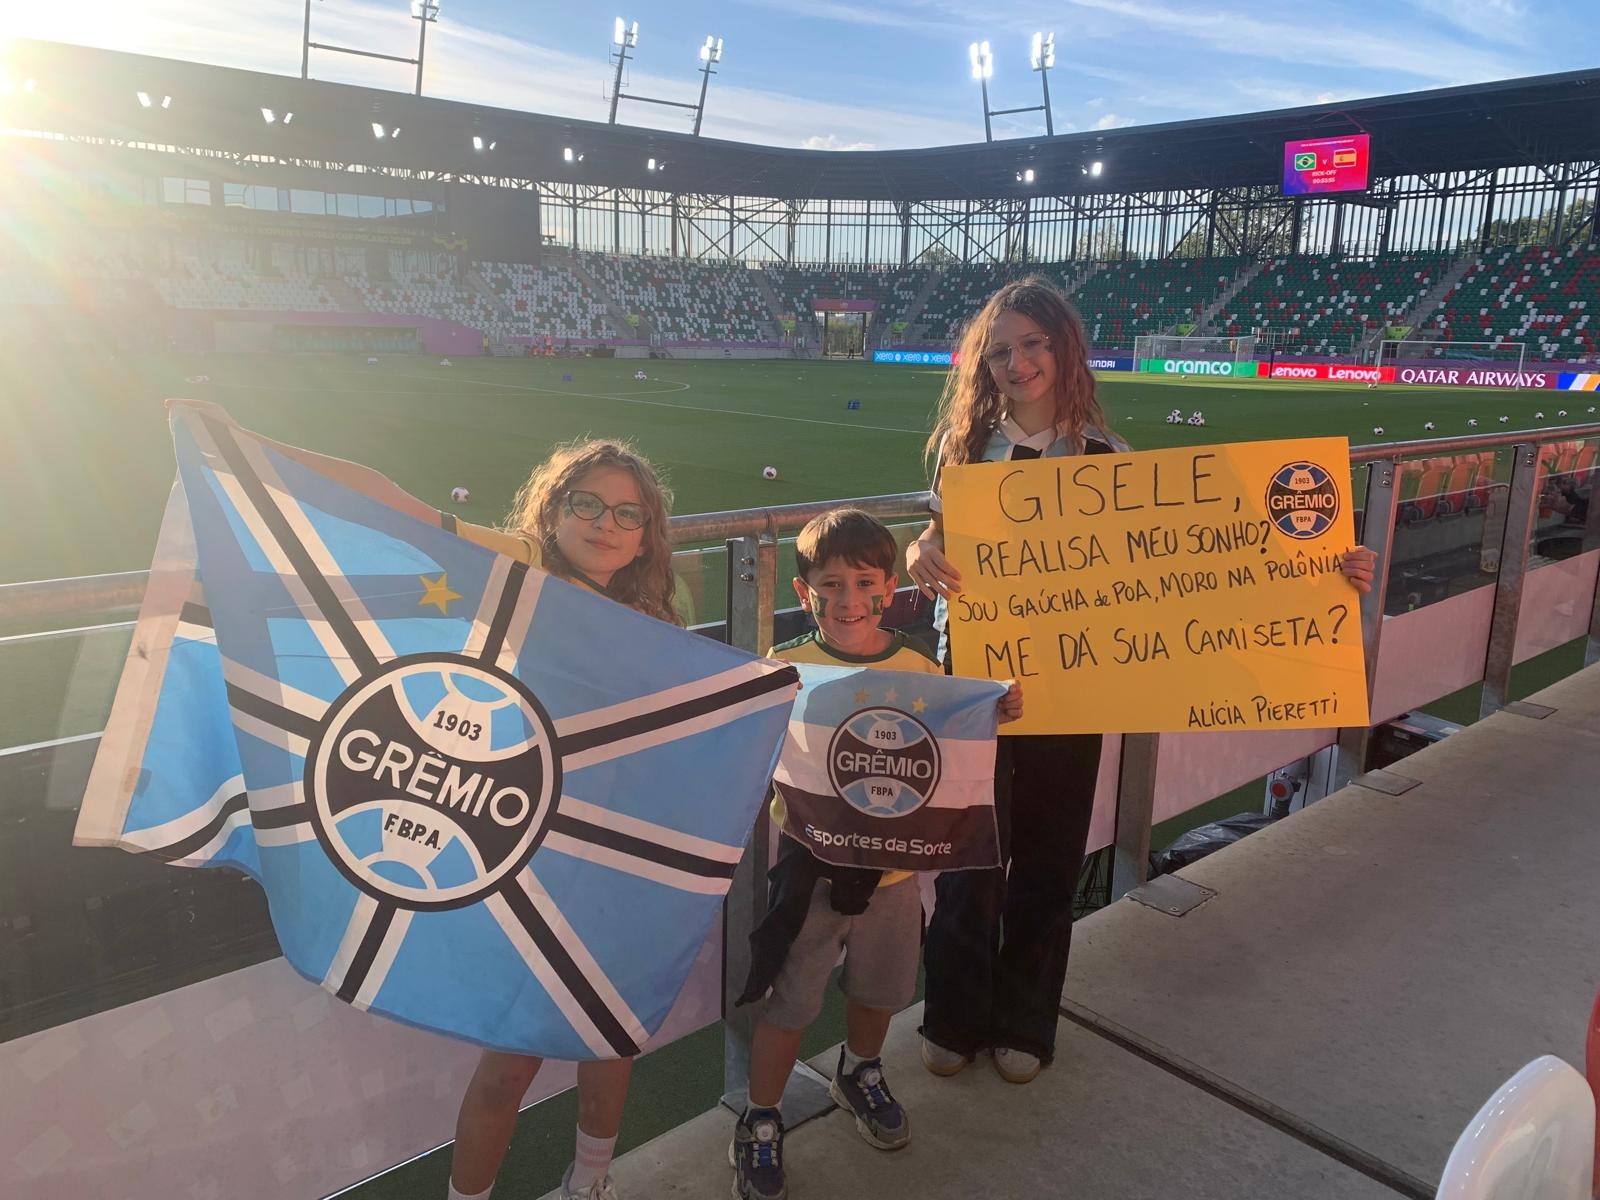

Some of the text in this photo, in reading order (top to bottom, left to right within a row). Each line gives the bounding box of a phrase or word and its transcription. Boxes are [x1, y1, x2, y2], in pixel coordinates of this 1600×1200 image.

[1312, 169, 1337, 177] KICK-OFF
[875, 352, 951, 363] xero xero xero
[1164, 360, 1232, 375] aramco
[1328, 367, 1382, 380] Lenovo
[1401, 369, 1546, 388] QATAR AIRWAYS
[998, 453, 1240, 523] GISELE,
[1294, 477, 1310, 485] 1903
[1270, 490, 1335, 510] GRÊMIO
[976, 520, 1271, 577] REALISA MEU SONHO?
[958, 594, 998, 623] SOU
[1008, 588, 1089, 619] GAÚCHA
[1111, 578, 1159, 604] POA,
[1159, 571, 1218, 599] MORO
[1228, 565, 1256, 589] NA
[984, 637, 1039, 678] ME
[1058, 626, 1099, 670] DÁ
[1113, 627, 1170, 665] SUA
[433, 710, 483, 742] 1903
[874, 729, 897, 741] 1903
[836, 748, 932, 779] GRÊMIO
[338, 728, 530, 828] GRÊMIO
[871, 785, 893, 797] FBPA
[805, 823, 882, 850] Esportes
